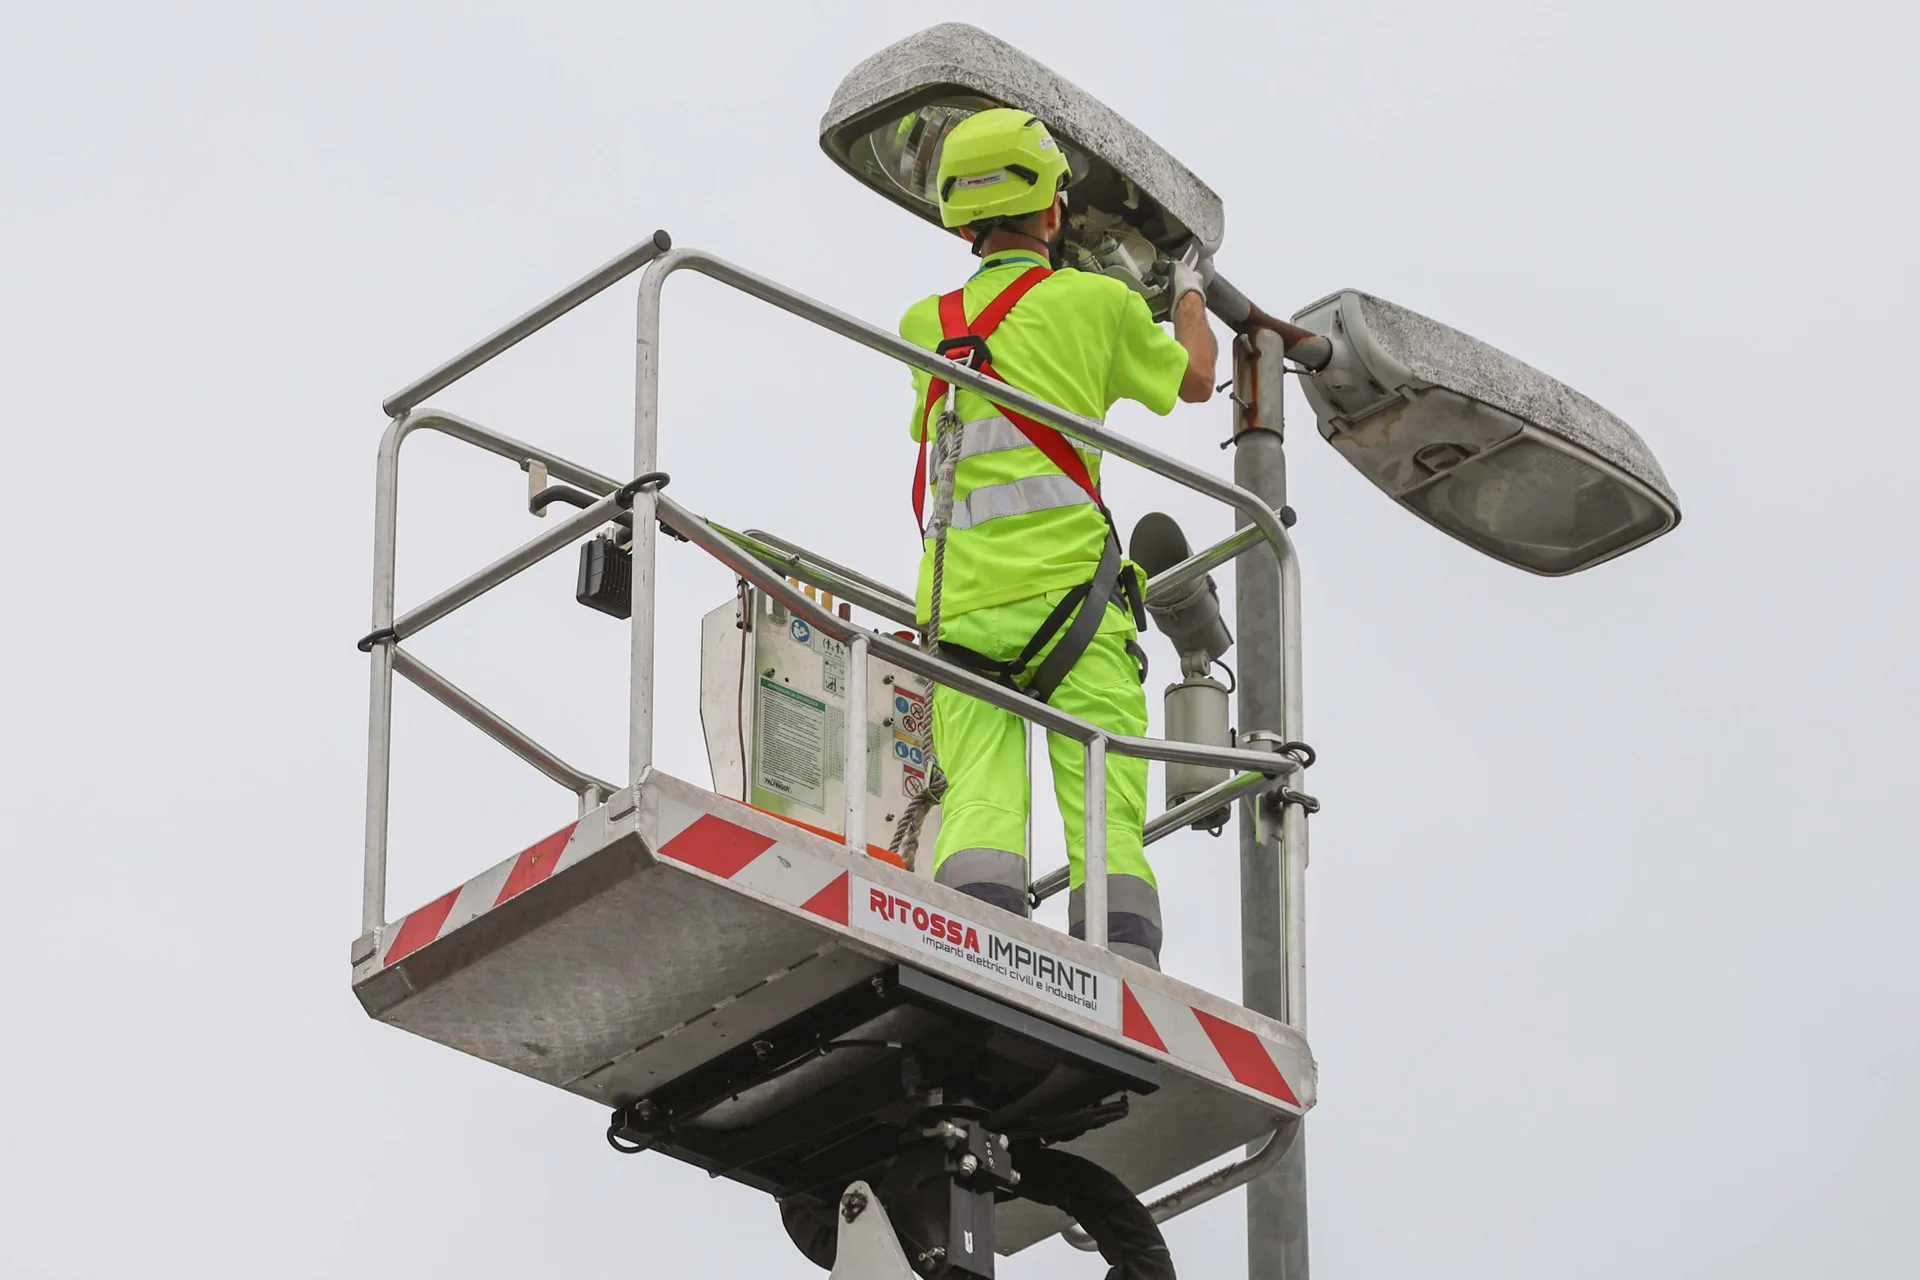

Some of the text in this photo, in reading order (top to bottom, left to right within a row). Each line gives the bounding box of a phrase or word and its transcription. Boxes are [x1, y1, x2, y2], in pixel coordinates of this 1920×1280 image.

[870, 888, 1097, 1000] RITOSSA IMPIANTI
[922, 934, 1097, 1011] impianti elettrici civili e industriali
